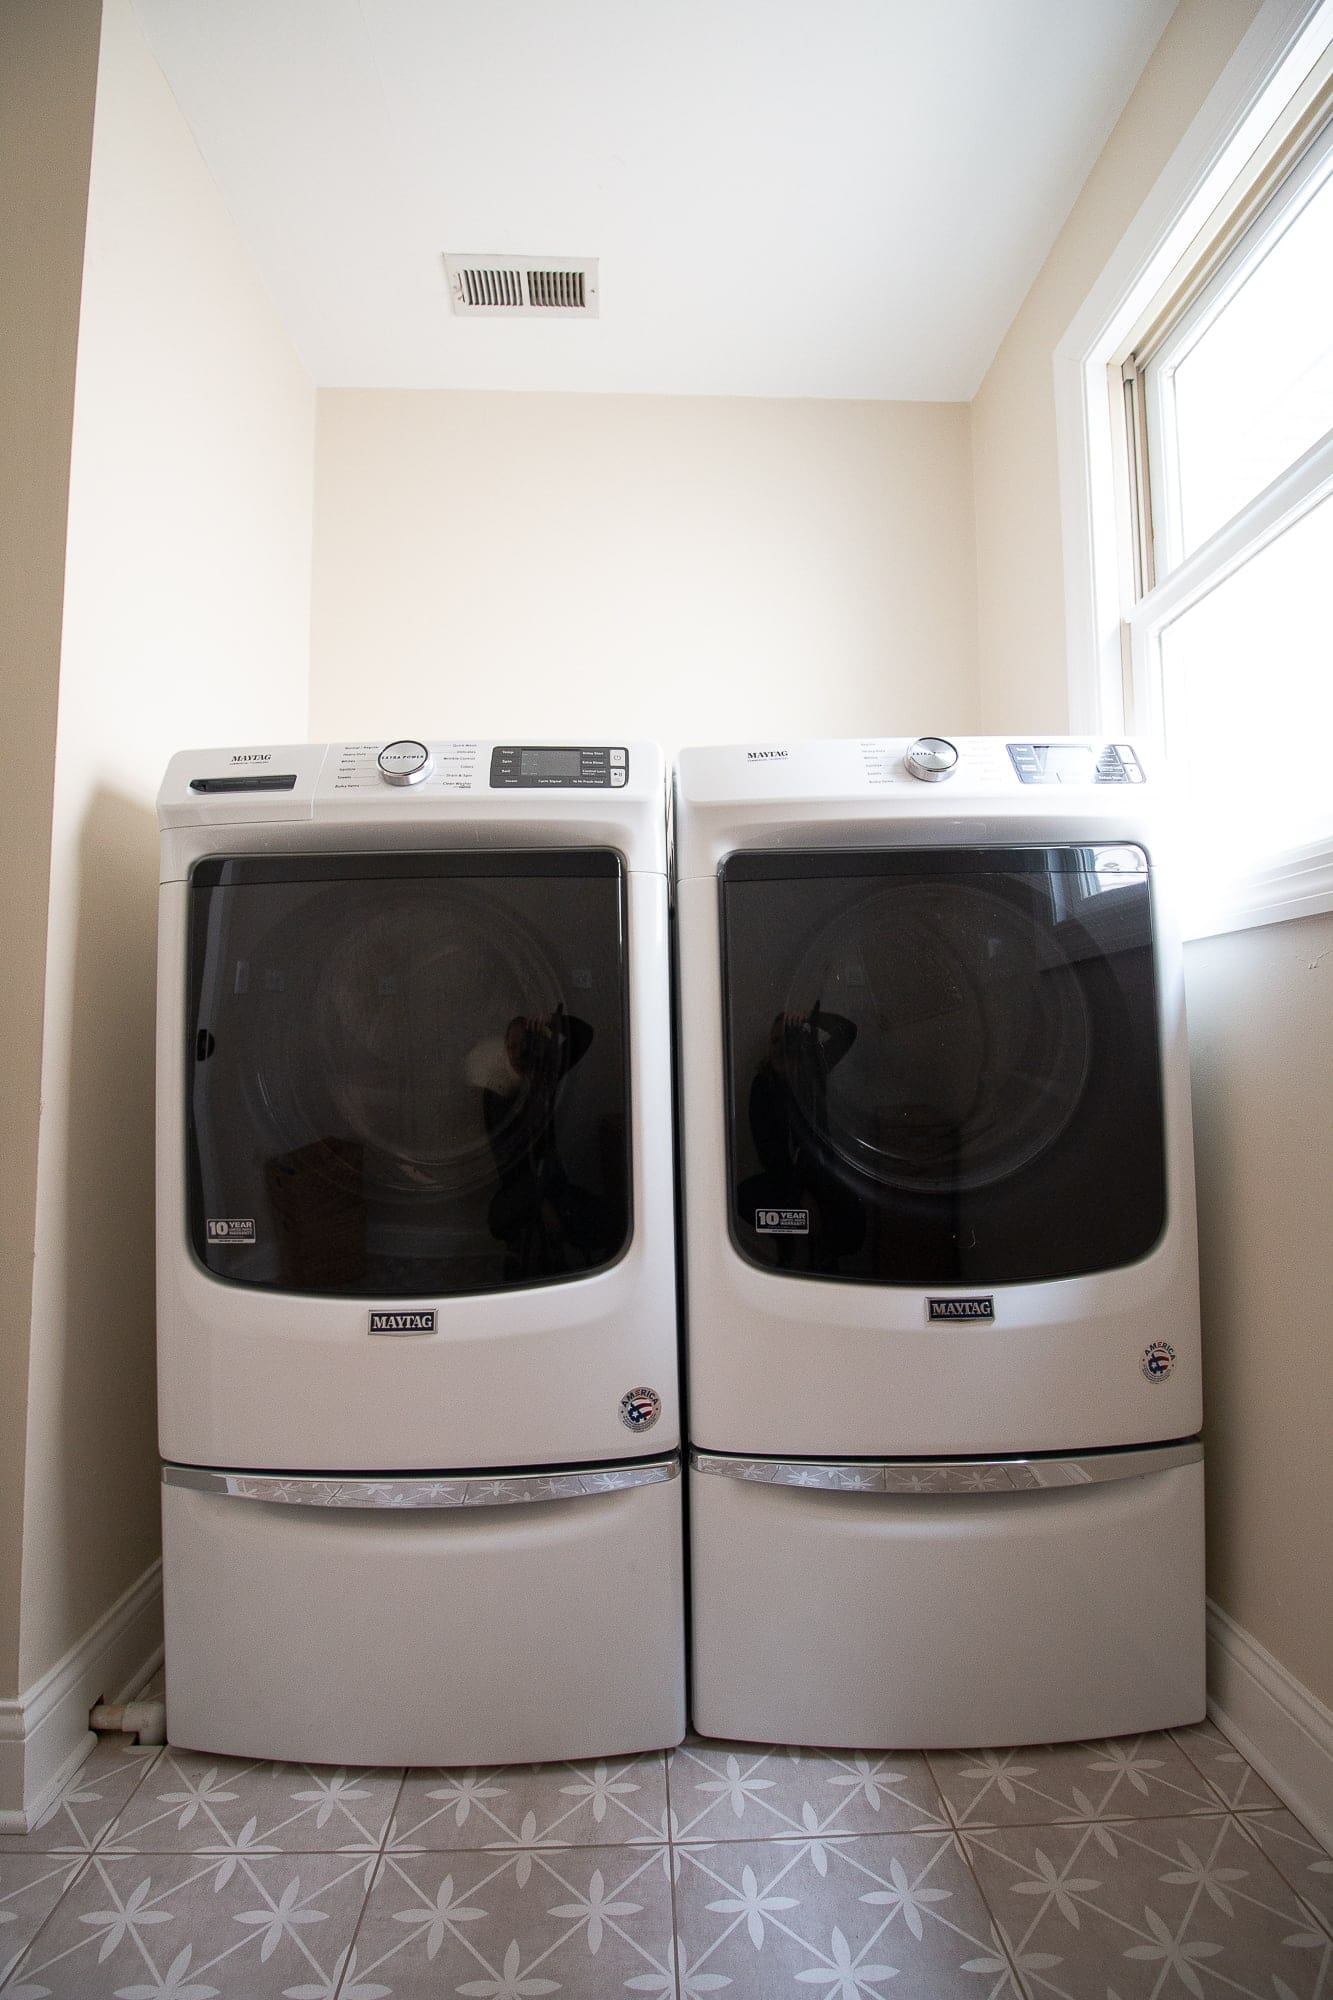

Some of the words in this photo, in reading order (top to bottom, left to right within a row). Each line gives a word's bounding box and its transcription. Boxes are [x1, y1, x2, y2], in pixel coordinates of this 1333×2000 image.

[231, 754, 272, 762] MAYTAG
[758, 1211, 780, 1226] 10
[209, 1221, 229, 1236] 10
[931, 1301, 992, 1316] MAYTAG
[372, 1315, 433, 1329] MAYTAG
[1144, 1341, 1176, 1361] AMERICA
[621, 1389, 659, 1408] AMERICA
